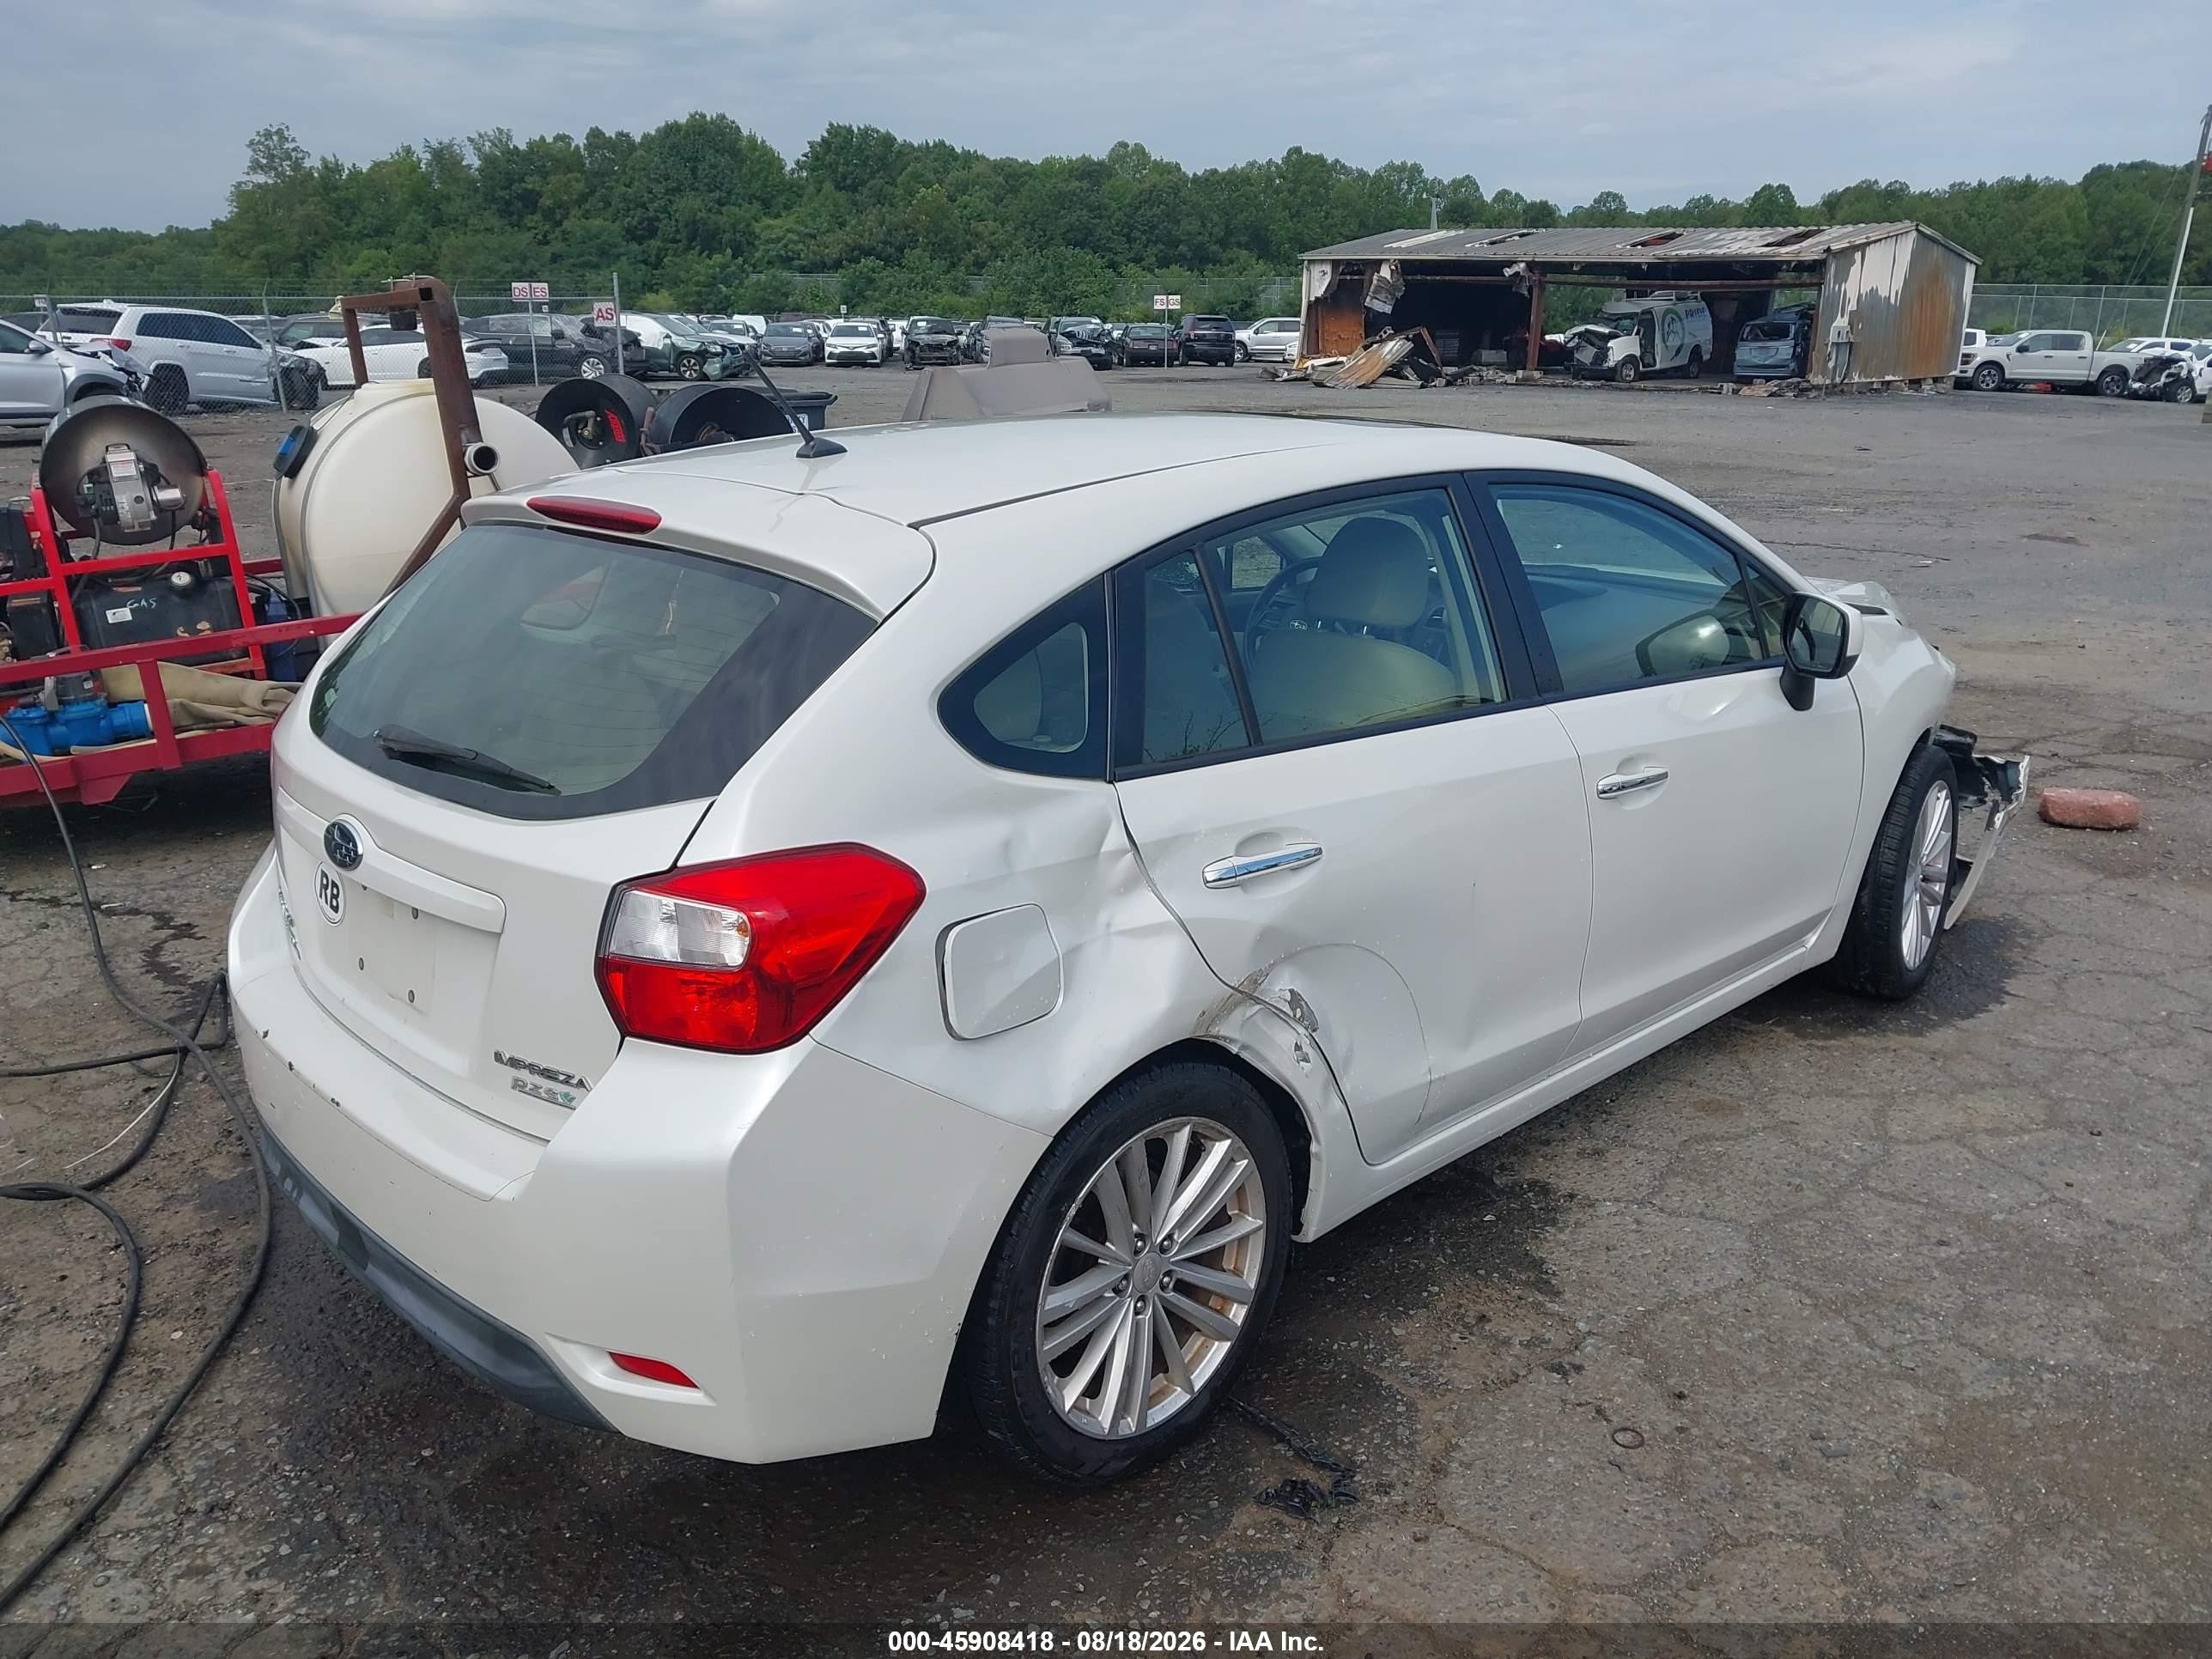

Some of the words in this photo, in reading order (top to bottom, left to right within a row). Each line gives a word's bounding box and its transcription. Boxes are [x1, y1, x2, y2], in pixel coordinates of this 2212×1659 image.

[513, 287, 528, 297] DS
[532, 288, 547, 297] ES
[1155, 298, 1165, 307] FS
[1169, 298, 1181, 307] GS
[595, 307, 614, 321] AS
[126, 597, 157, 609] GAS
[319, 868, 341, 915] RB
[494, 1049, 592, 1092] IMPREZA
